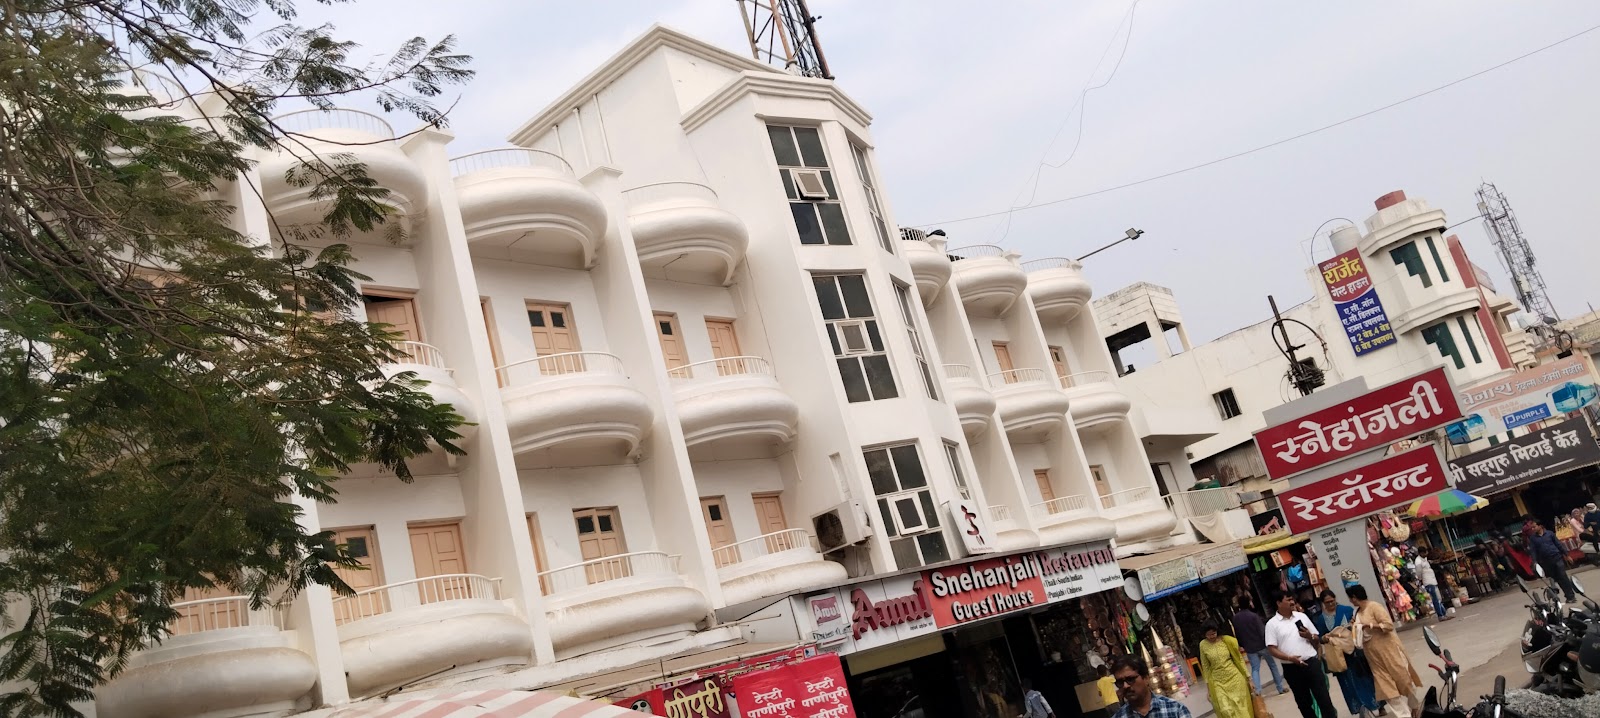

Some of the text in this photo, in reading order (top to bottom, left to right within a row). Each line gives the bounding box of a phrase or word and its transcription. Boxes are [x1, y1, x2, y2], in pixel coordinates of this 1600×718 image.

[1323, 257, 1363, 283] राजेंद्र
[1355, 344, 1362, 353] 6
[1272, 380, 1443, 464] स्नेहांजली
[1516, 408, 1545, 421] PURPLE
[1510, 433, 1552, 463] मिठाई
[1552, 429, 1581, 449] केंद्र
[1288, 463, 1432, 521] रेस्टॉरन्ट
[1040, 549, 1115, 575] Restaurant
[931, 554, 1038, 597] Snehanjali
[814, 602, 840, 621] Amul
[851, 579, 933, 641] Amul
[952, 590, 1034, 621] Guest House
[752, 687, 783, 704] टेस्टी
[801, 686, 848, 708] पाणीपुरी
[806, 676, 834, 693] टेस्टी
